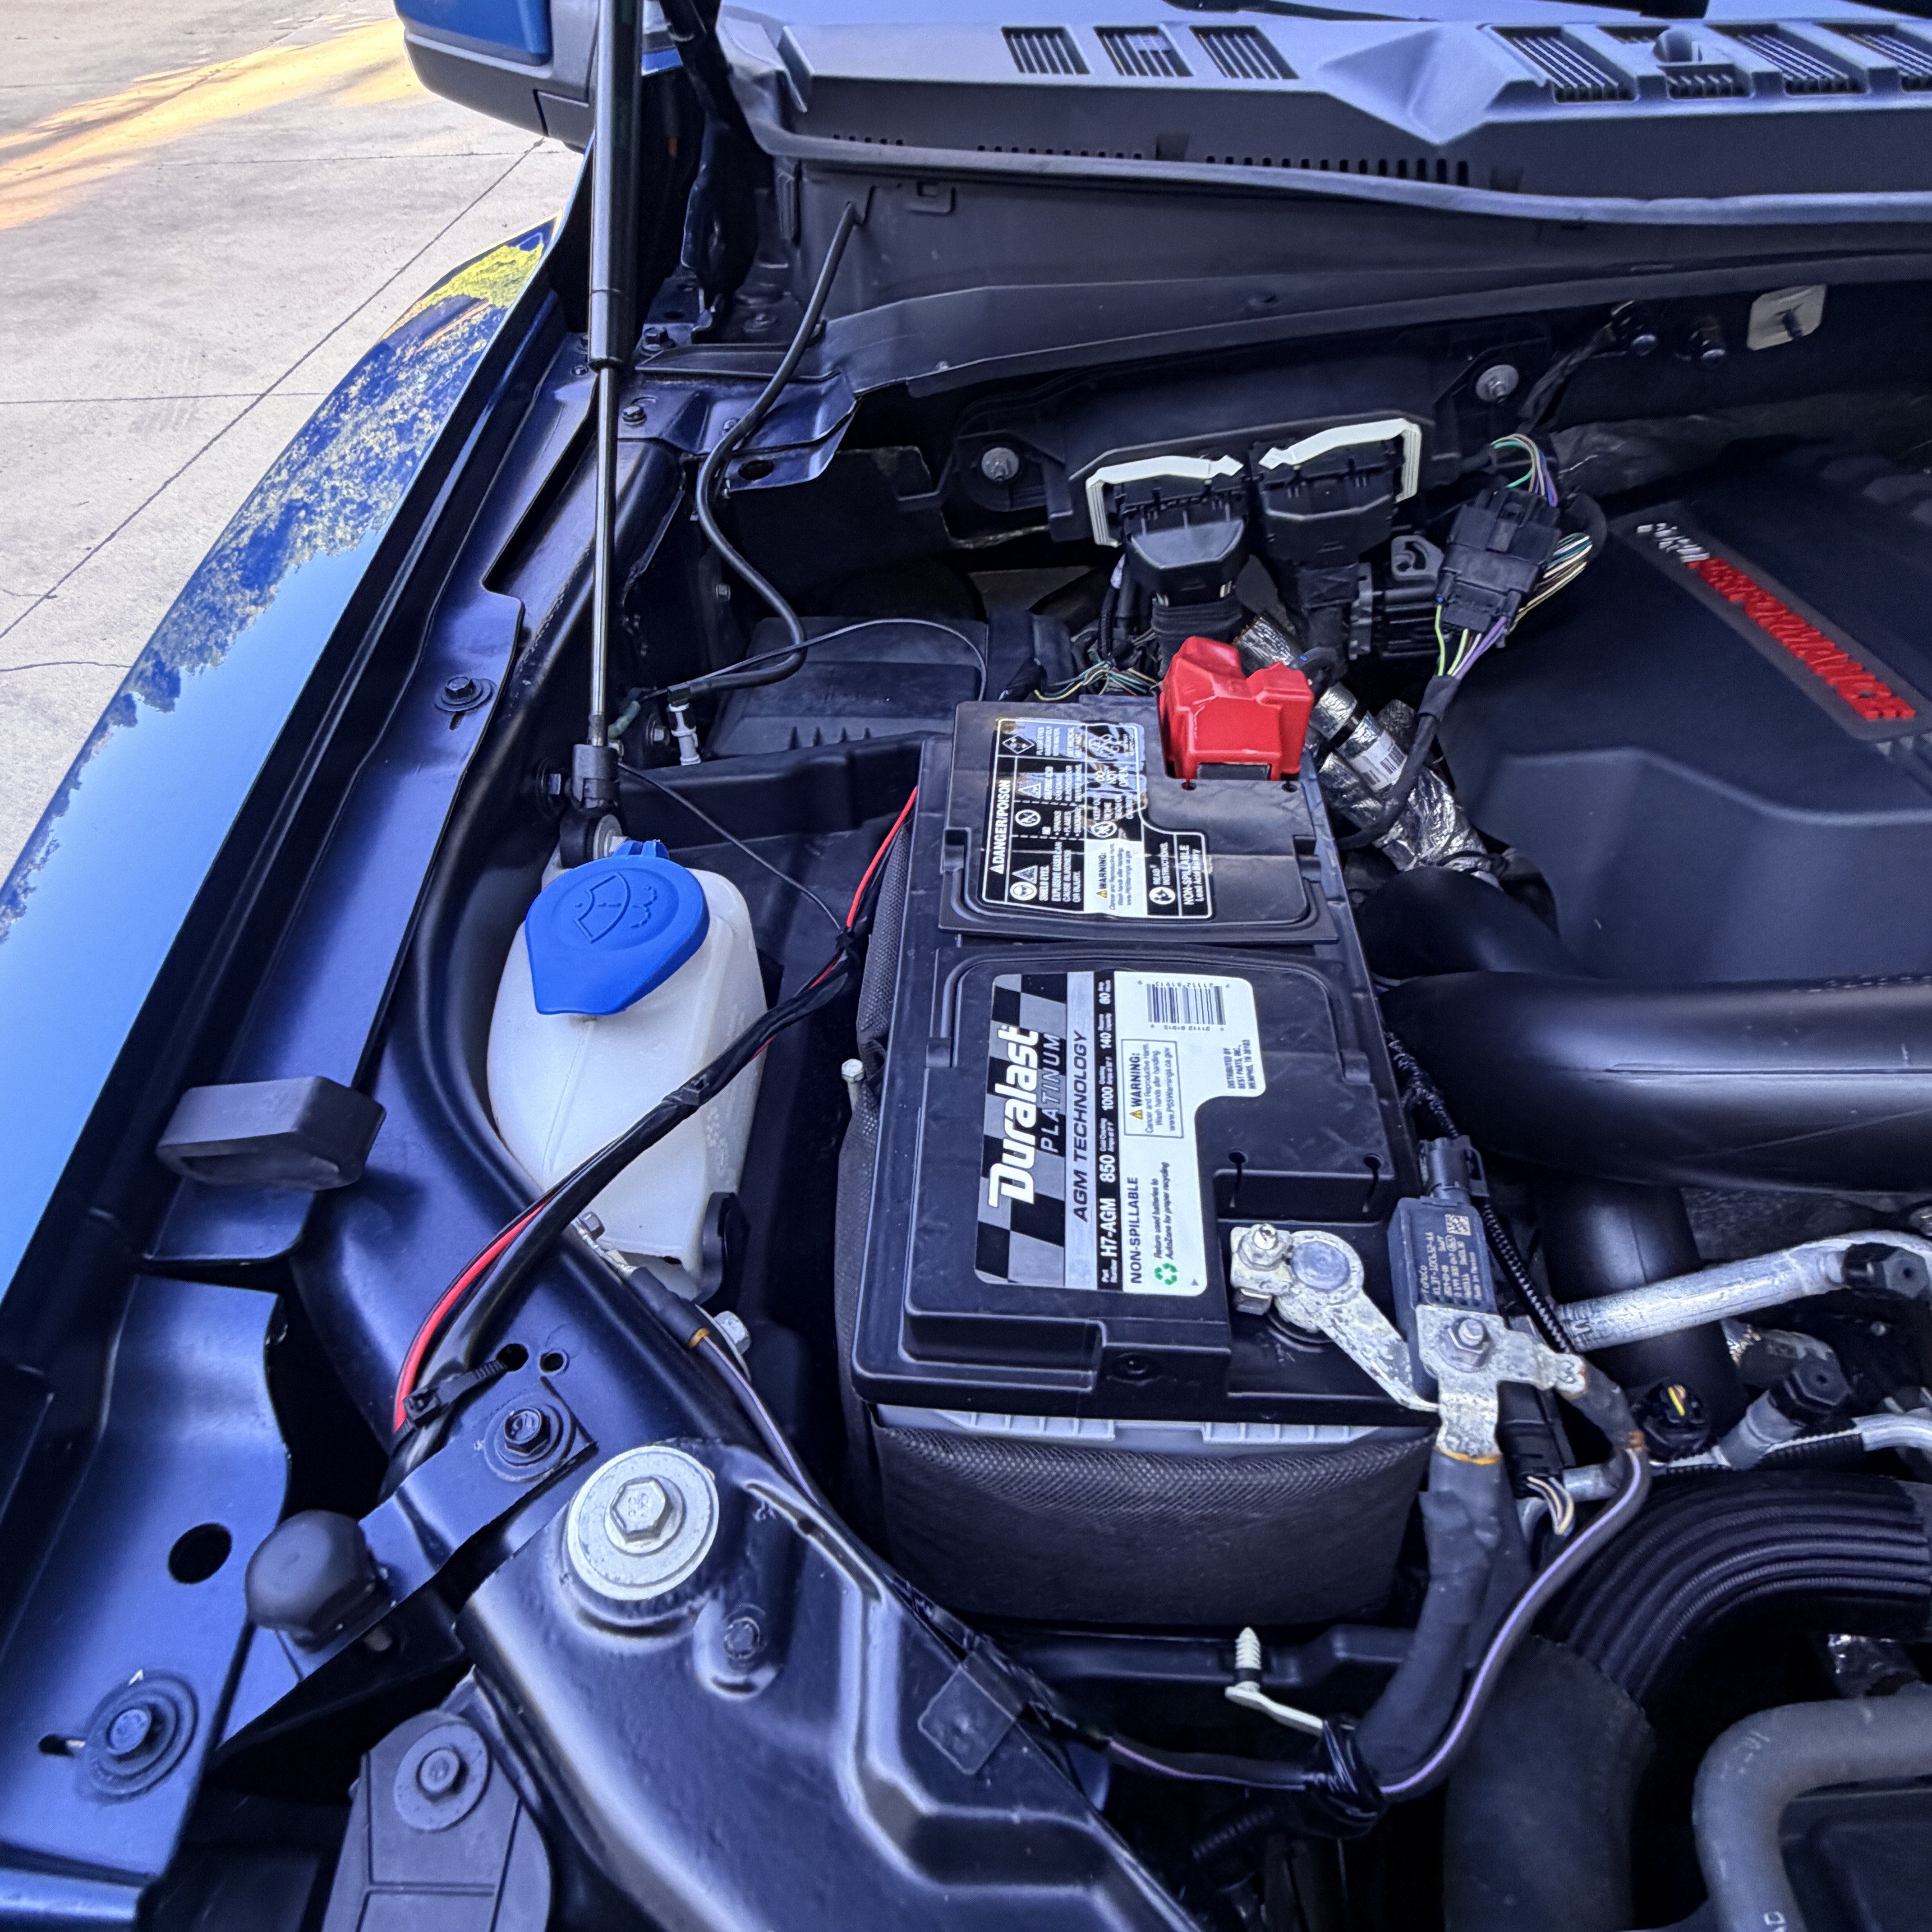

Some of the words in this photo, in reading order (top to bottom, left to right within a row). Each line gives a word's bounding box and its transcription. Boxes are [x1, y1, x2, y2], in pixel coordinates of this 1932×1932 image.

[992, 780, 1011, 864] DANGER/POISON
[1098, 852, 1107, 889] WARNING:
[1152, 868, 1161, 885] READ
[1179, 845, 1194, 905] NON-SPILLABLE
[1099, 992, 1111, 1005] 80
[1099, 1032, 1112, 1049] 140
[1040, 1032, 1061, 1153] PLATINUM
[1129, 1053, 1142, 1107] WARNING:
[1143, 1061, 1152, 1097] Reproductive
[1164, 1047, 1176, 1131] www.P65Warnings.ca.gov
[1236, 1076, 1246, 1089] BEST
[1073, 1030, 1087, 1162] TECHNOLOGY
[1100, 1086, 1114, 1110] 1000
[1144, 1099, 1152, 1110] and
[988, 1026, 1038, 1208] Duralast
[1145, 1111, 1154, 1133] Cancer
[1155, 1109, 1163, 1126] Wash
[1099, 1155, 1116, 1183] 850
[1073, 1169, 1087, 1222] AGM
[1150, 1187, 1160, 1215] batteries
[1163, 1192, 1173, 1214] proper
[1099, 1198, 1118, 1257] H7-AGM
[1127, 1177, 1142, 1283] NON-SPILLABLE
[1152, 1216, 1161, 1233] used
[1163, 1214, 1171, 1224] for
[1153, 1235, 1162, 1259] Return
[1164, 1225, 1174, 1260] AutoZone
